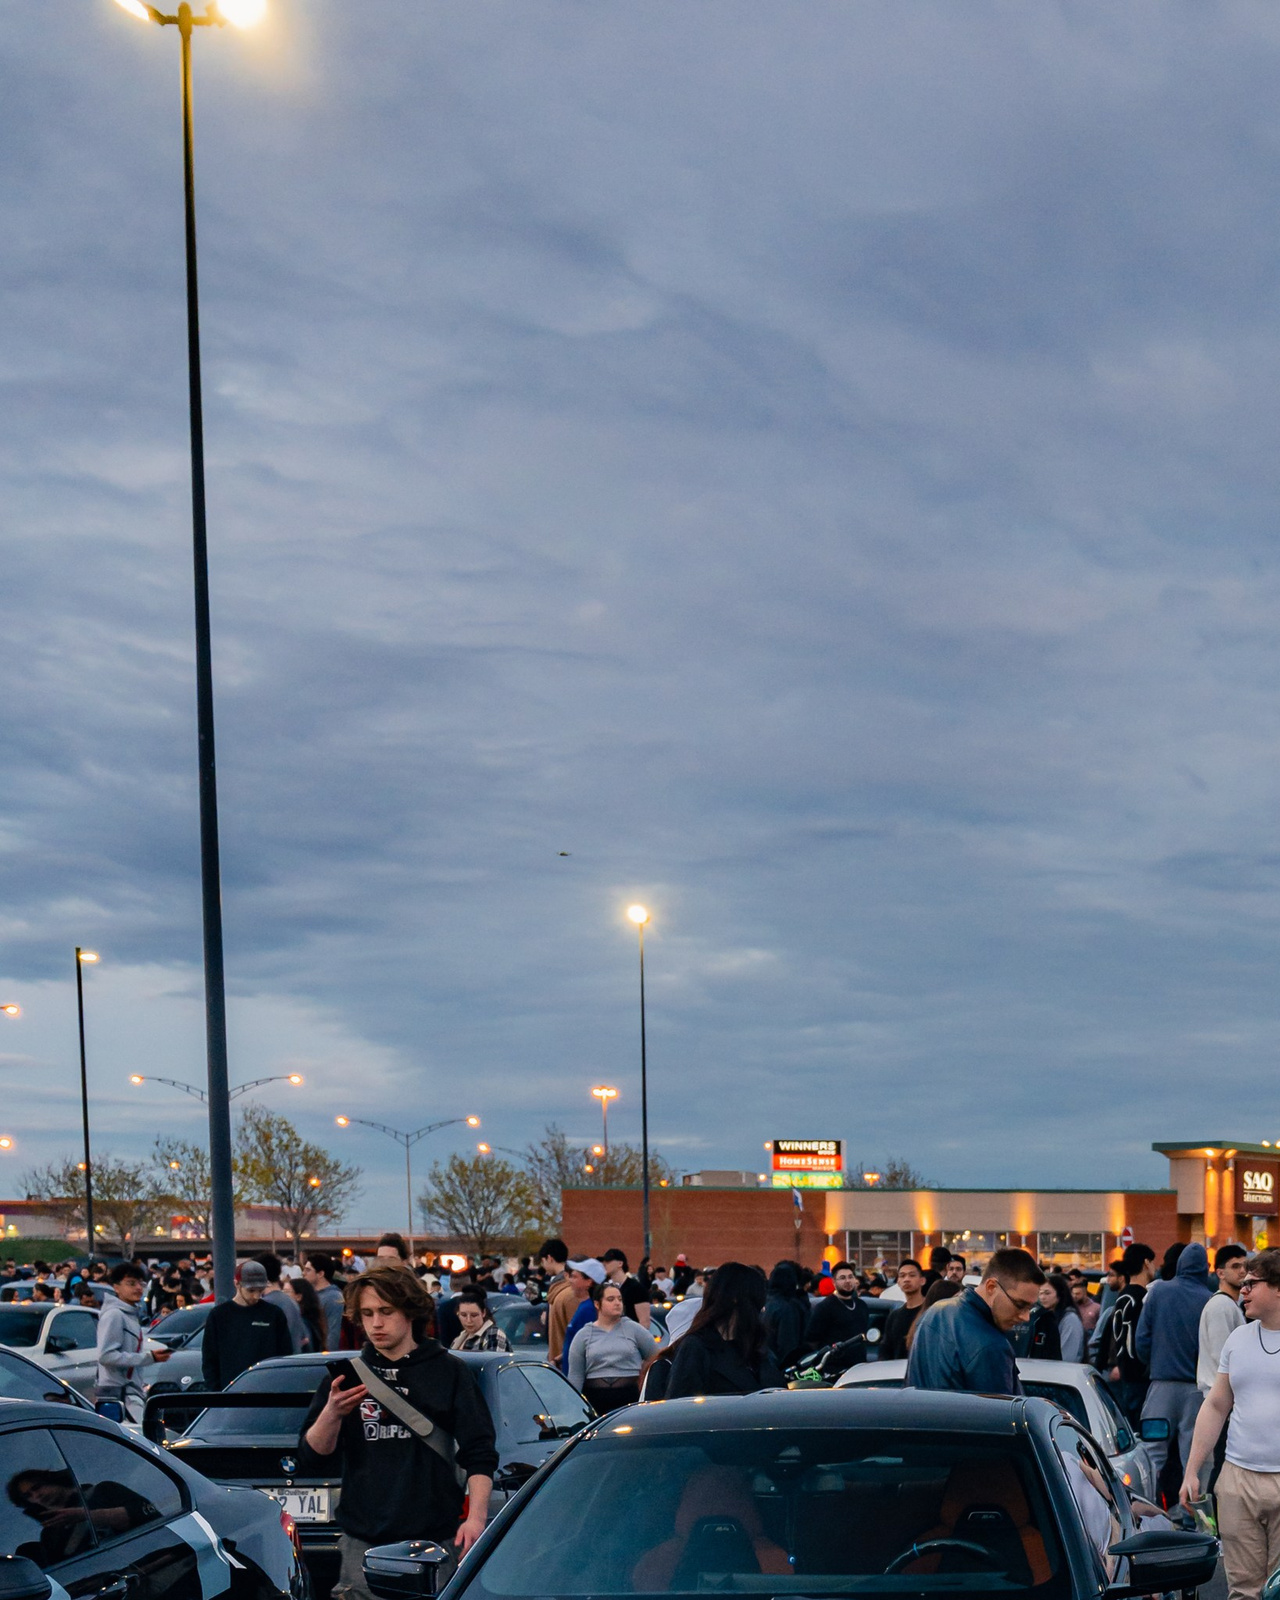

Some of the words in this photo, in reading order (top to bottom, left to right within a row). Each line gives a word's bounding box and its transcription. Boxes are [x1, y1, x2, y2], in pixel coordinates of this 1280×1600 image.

[779, 1141, 836, 1151] WINNERS
[1243, 1170, 1274, 1191] SAQ
[380, 1425, 411, 1439] REPEA
[299, 1495, 326, 1513] YAL
